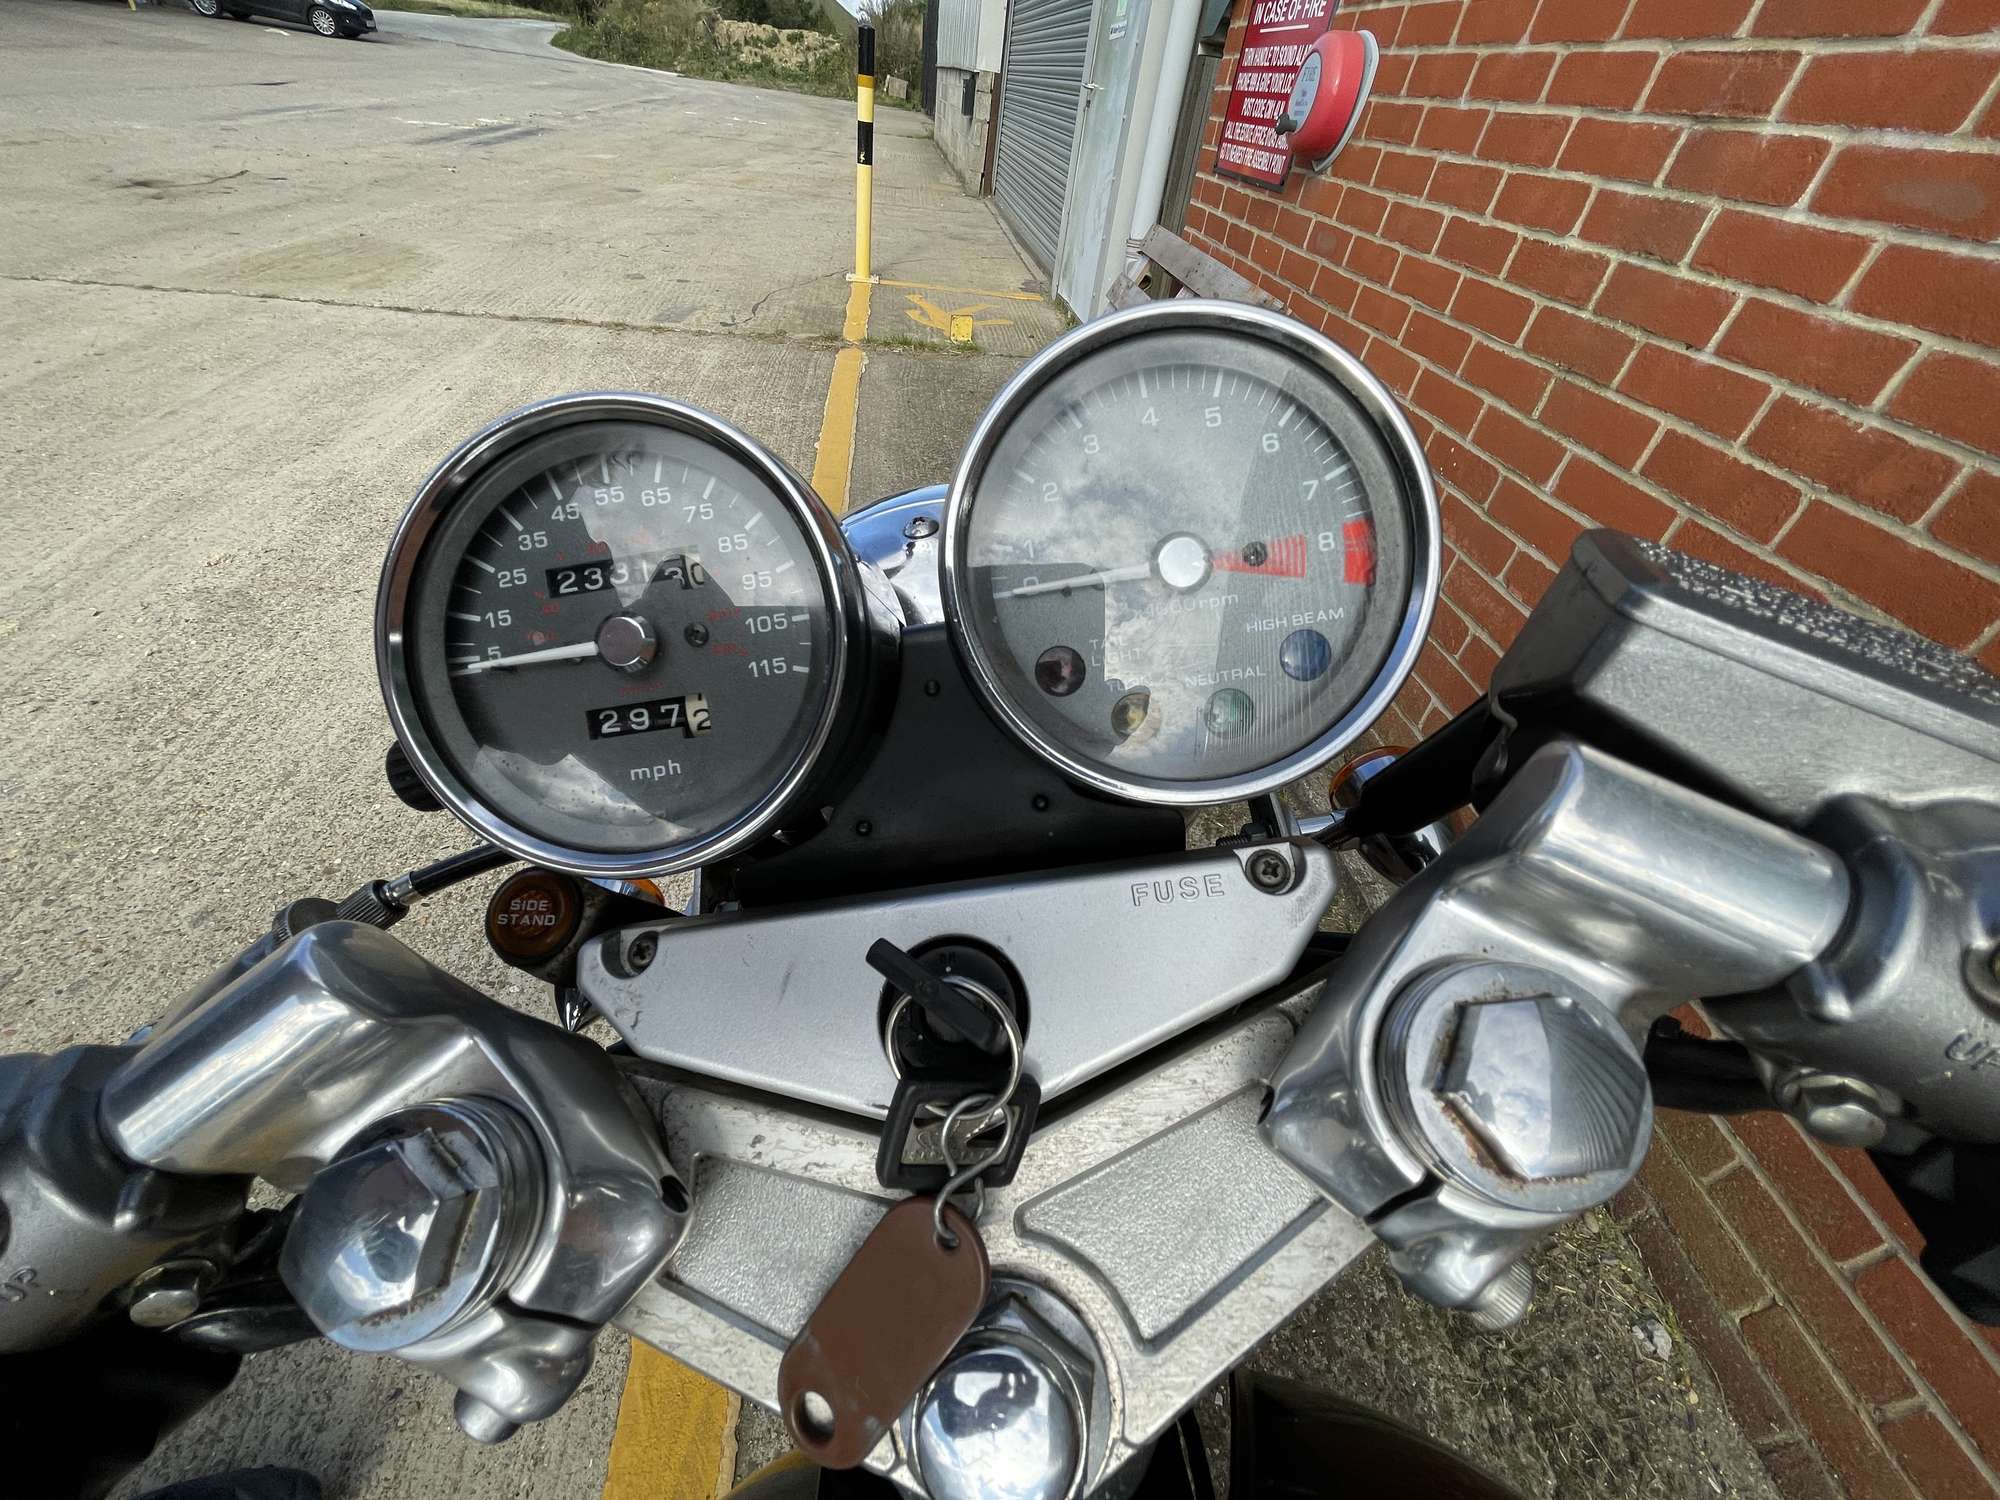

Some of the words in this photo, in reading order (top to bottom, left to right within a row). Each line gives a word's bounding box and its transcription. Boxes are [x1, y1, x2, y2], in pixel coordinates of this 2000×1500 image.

[1253, 3, 1265, 25] IN
[1264, 0, 1289, 24] CASE
[1288, 0, 1302, 21] OF
[1302, 0, 1327, 19] FIRE
[1142, 408, 1160, 427] 4
[1204, 407, 1222, 428] 5
[1084, 434, 1100, 454] 3
[1262, 433, 1280, 453] 6
[594, 486, 625, 505] 55
[641, 487, 671, 507] 65
[1042, 482, 1060, 502] 2
[1302, 480, 1319, 501] 7
[551, 502, 581, 522] 45
[683, 503, 714, 523] 75
[518, 531, 548, 551] 35
[717, 533, 749, 553] 85
[1318, 532, 1336, 552] 8
[498, 568, 528, 588] 25
[742, 571, 772, 591] 95
[485, 610, 512, 629] 15
[745, 613, 788, 633] 105
[1246, 617, 1288, 633] HIGH
[1292, 608, 1344, 627] BEAM
[487, 646, 502, 660] 5
[747, 658, 788, 678] 115
[1184, 666, 1267, 688] NEUTRAL
[599, 703, 712, 734] 2972
[630, 760, 681, 781] mph
[1131, 874, 1225, 906] FUSE
[510, 900, 550, 911] SIDE
[497, 914, 556, 926] STAND
